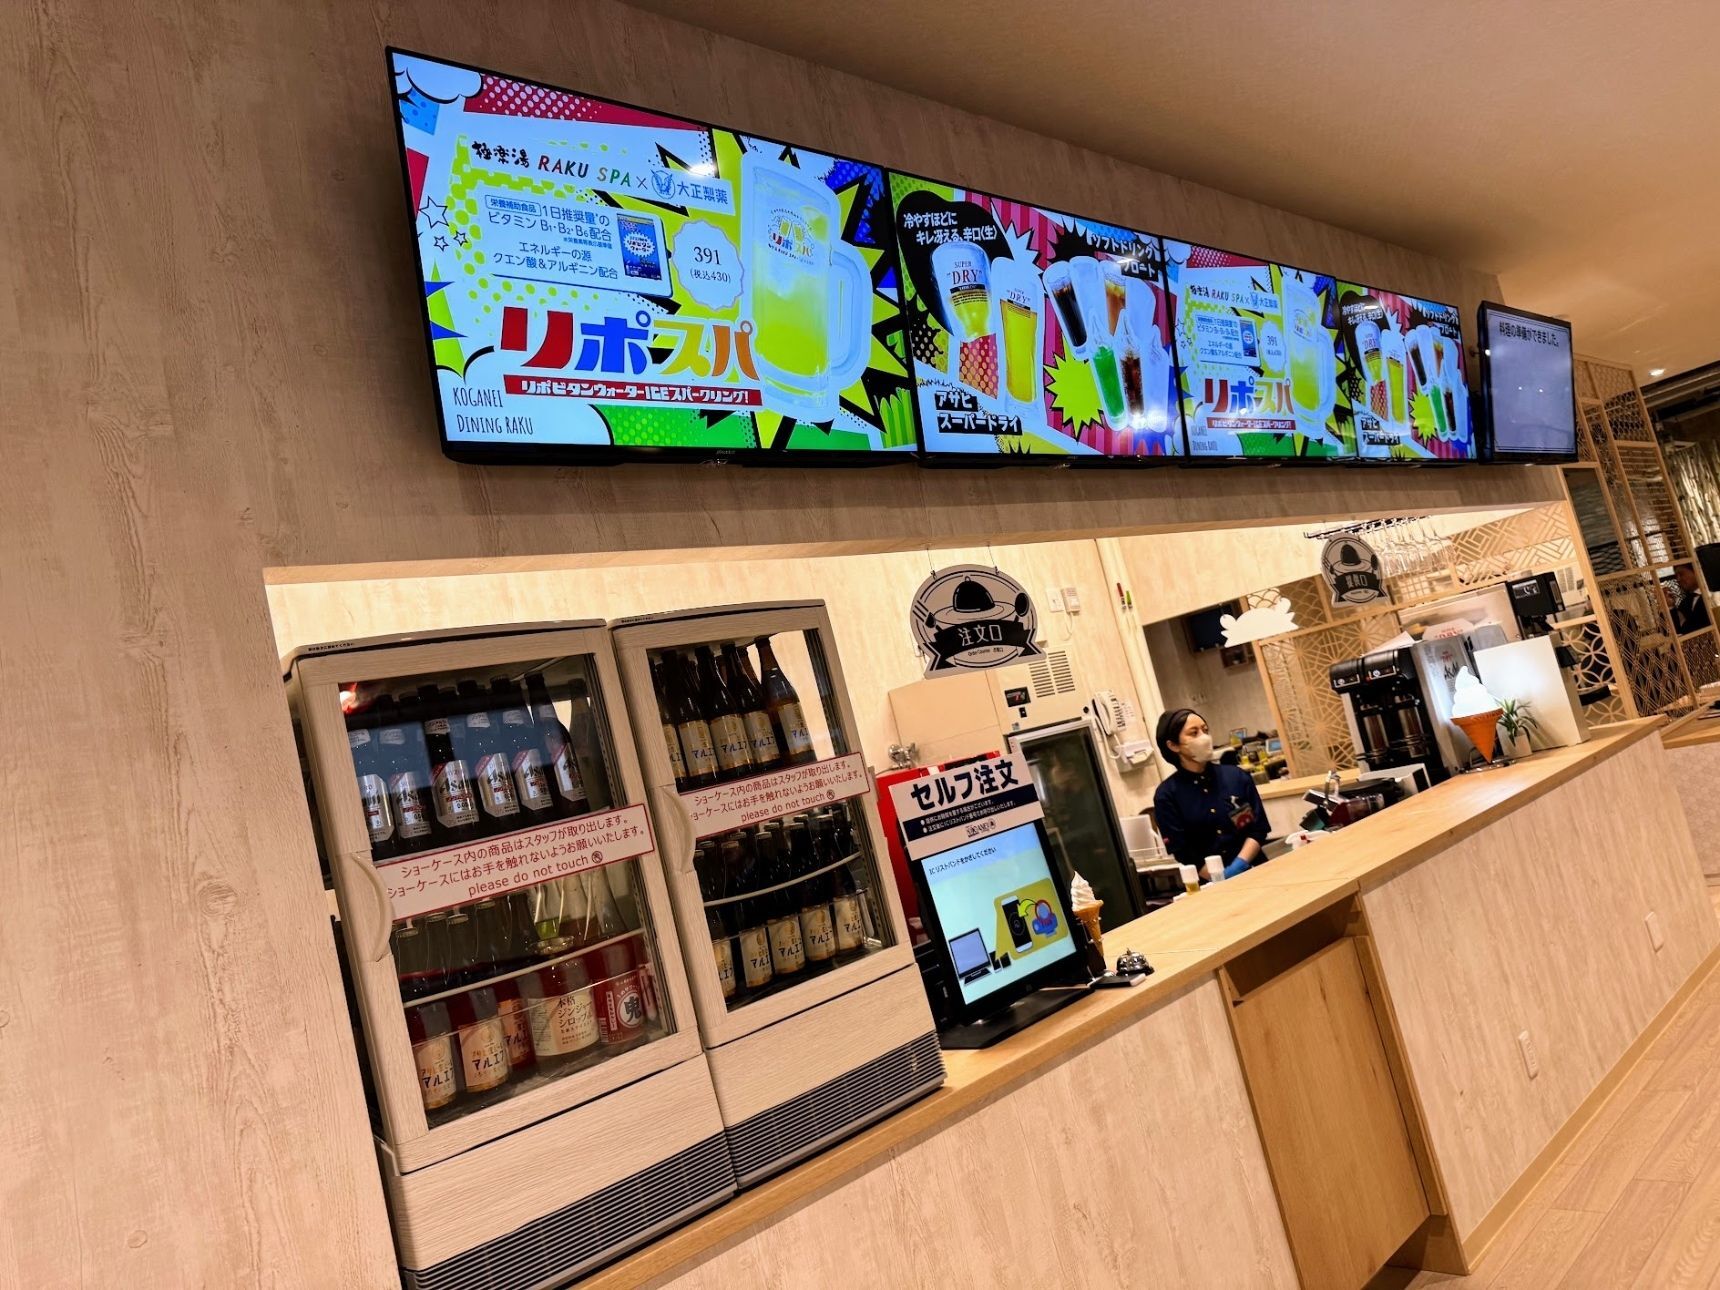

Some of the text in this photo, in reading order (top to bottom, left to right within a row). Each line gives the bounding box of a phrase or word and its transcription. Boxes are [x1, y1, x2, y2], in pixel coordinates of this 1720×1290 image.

[471, 141, 530, 168] 極楽湯
[538, 155, 589, 178] RAKU
[597, 166, 631, 187] SPA
[677, 181, 728, 205] 大正製薬
[903, 211, 958, 229] 冷やすほどに
[519, 242, 592, 262] エネルギーの源
[693, 246, 722, 265] 391
[500, 304, 760, 381] リポスパ
[453, 387, 503, 408] KOGANEI
[937, 391, 974, 410] アサヒ
[1204, 376, 1294, 414] リポスパ
[457, 414, 533, 436] DINING RAKU
[939, 413, 1021, 433] スーパードライ
[957, 624, 1003, 647] 注文口
[691, 770, 862, 821] ョーケースにはお手を触れないようお願いいたします。
[911, 760, 1019, 811] セルフ注文
[741, 793, 826, 823] please do not touch
[401, 814, 628, 879] ショーケース内の商品はスタッフが取り出します。
[387, 826, 645, 899] ショーケースにはお手を触れないようお願いいたします。
[468, 854, 588, 898] please do not touch
